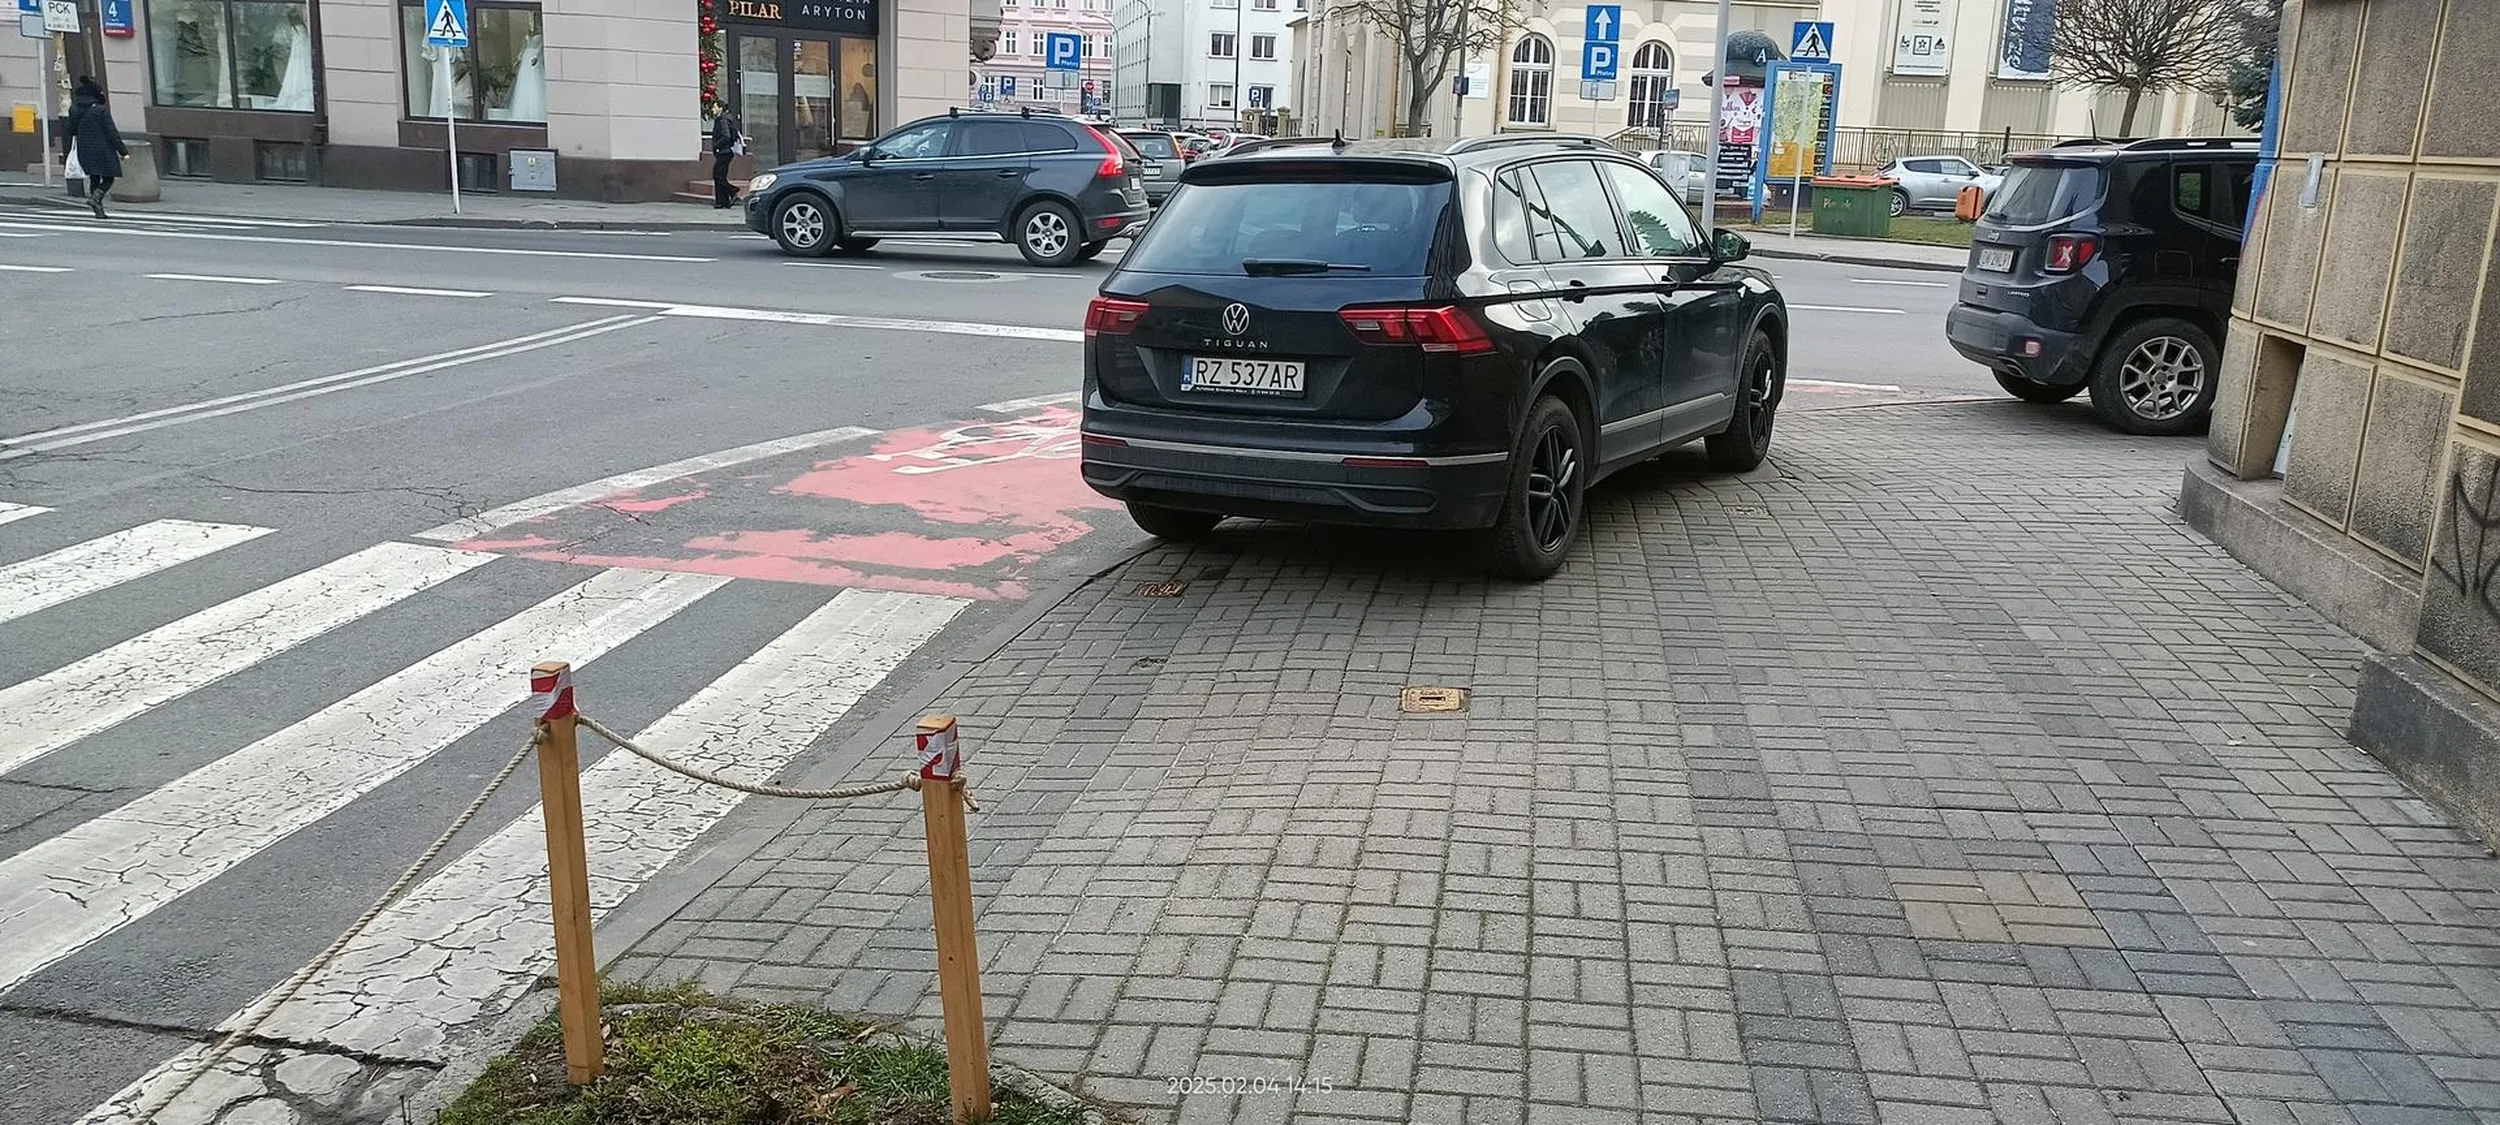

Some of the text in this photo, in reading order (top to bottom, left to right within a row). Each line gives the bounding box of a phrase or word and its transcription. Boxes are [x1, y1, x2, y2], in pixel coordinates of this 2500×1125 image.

[48, 2, 71, 15] PCK
[108, 1, 118, 18] 4
[728, 0, 782, 19] PILAR
[801, 4, 866, 20] ARYTON
[1054, 37, 1075, 65] P
[1755, 48, 1766, 62] A
[1590, 47, 1611, 75] P
[1003, 78, 1013, 90] P
[1251, 90, 1260, 100] P
[1204, 338, 1269, 349] TIGUAN
[1195, 360, 1299, 389] RZ 537AR
